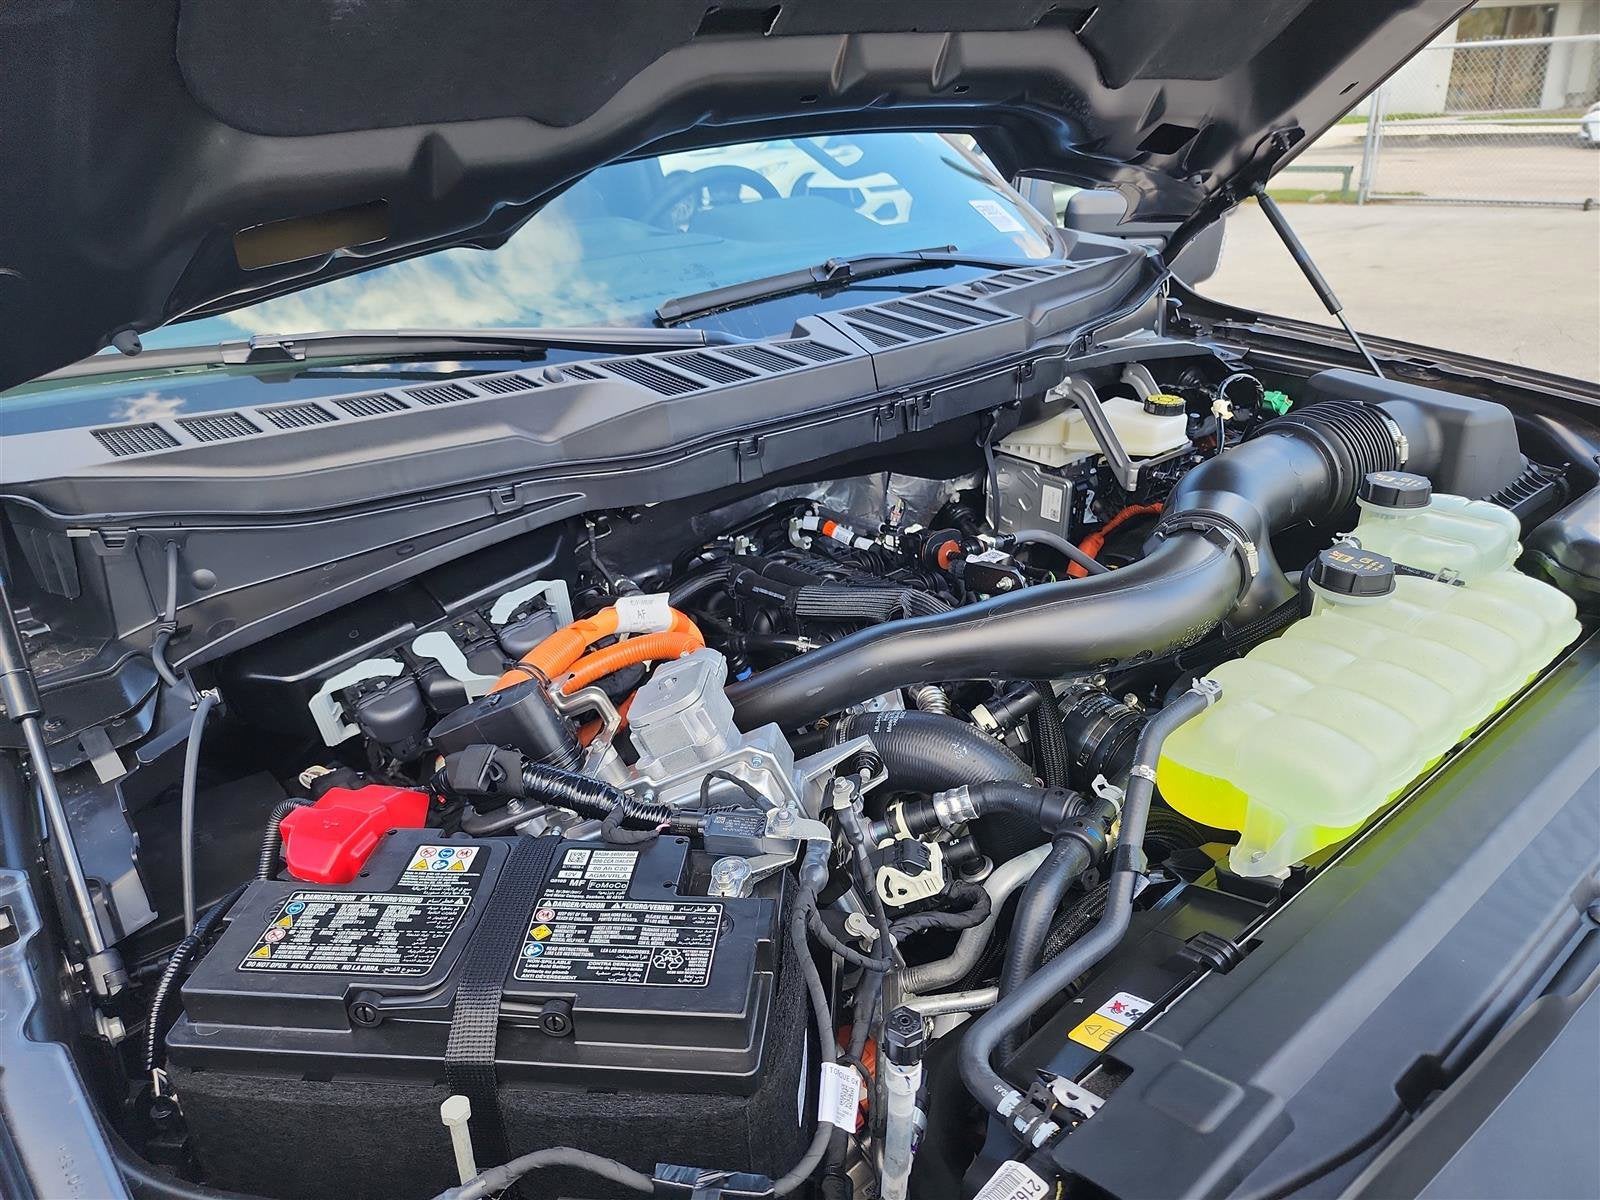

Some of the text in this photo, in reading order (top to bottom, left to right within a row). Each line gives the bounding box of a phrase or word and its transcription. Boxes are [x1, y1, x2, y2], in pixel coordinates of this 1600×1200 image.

[589, 881, 627, 889] FoMoCo
[552, 901, 606, 909] DANGER/POISON
[621, 902, 674, 911] PELIGRO/VENENO
[829, 1066, 850, 1082] TORQUE
